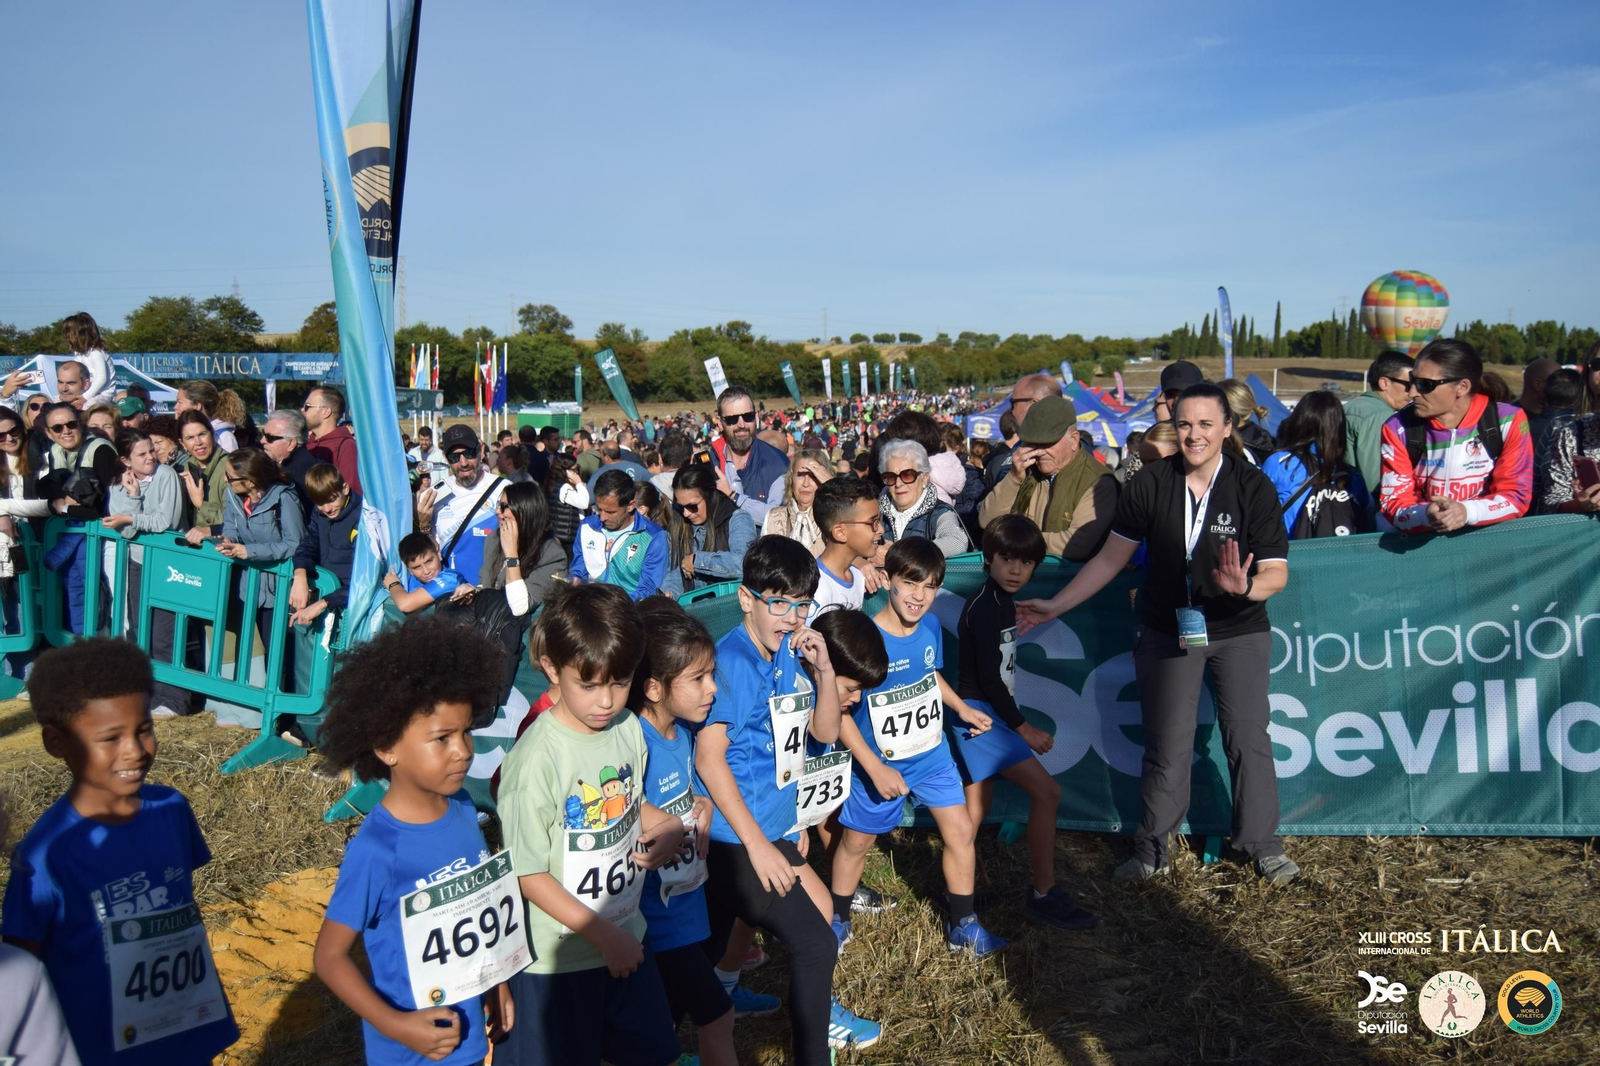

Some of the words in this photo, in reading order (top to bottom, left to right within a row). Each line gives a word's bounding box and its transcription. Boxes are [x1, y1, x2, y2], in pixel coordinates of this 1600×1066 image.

[156, 356, 184, 366] CROSS
[194, 352, 262, 375] ITÁLICA
[1211, 524, 1236, 533] ITÁLICA
[892, 684, 926, 702] ITÁLICA
[882, 699, 941, 738] 4764
[805, 756, 834, 772] TÁLICA
[659, 776, 669, 786] Los
[660, 784, 669, 793] del
[796, 775, 843, 809] 733
[604, 814, 633, 845] ITÁLICA
[105, 871, 150, 904] ES
[439, 868, 493, 900] ITÁLICA
[422, 894, 519, 965] 4692
[125, 944, 207, 1002] 4600
